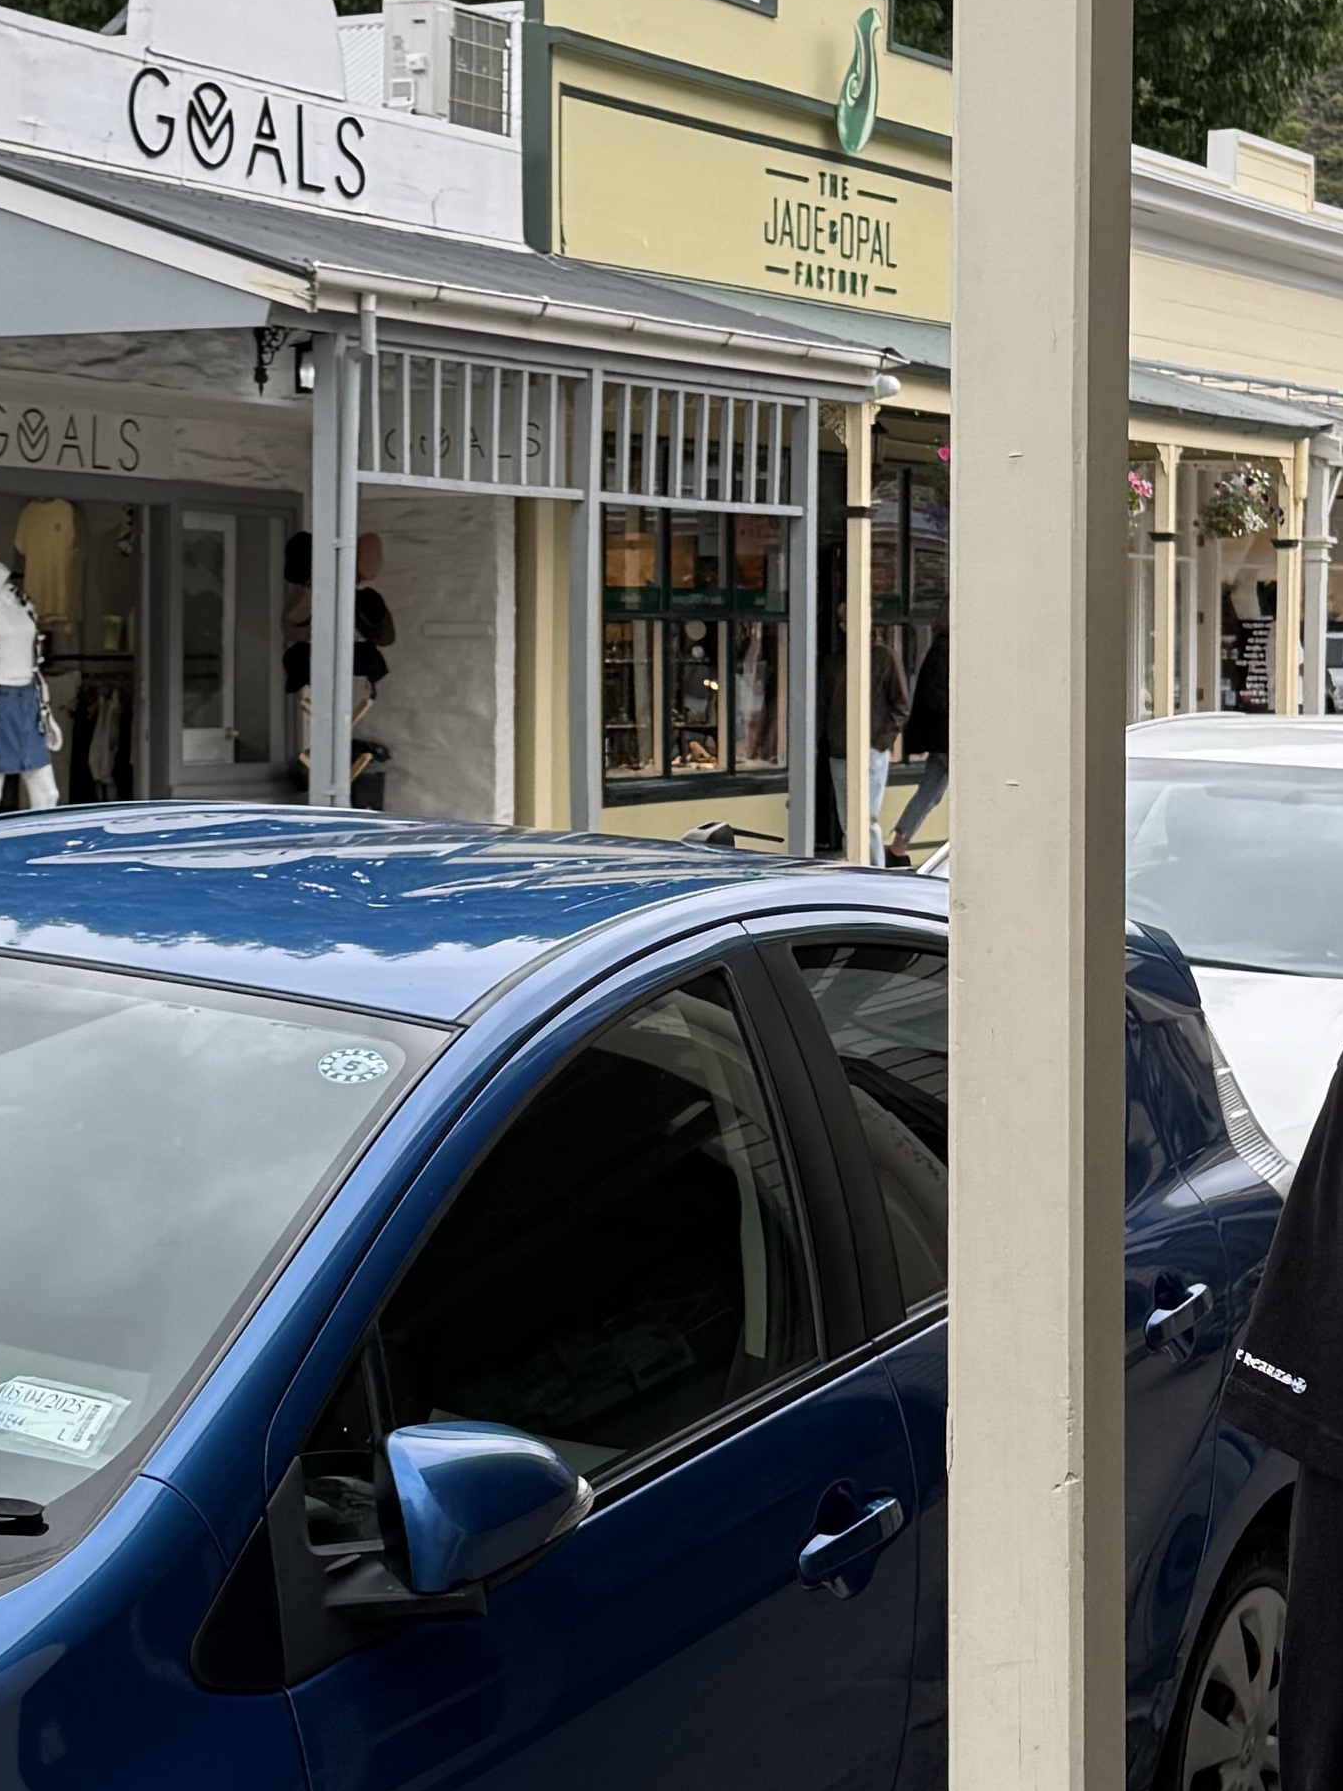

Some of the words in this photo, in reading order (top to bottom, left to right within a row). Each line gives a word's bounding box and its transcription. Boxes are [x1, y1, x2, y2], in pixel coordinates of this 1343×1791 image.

[128, 66, 366, 199] GOALS
[818, 171, 849, 200] THE
[764, 197, 826, 254] JADE
[840, 212, 897, 269] OPAL
[794, 261, 868, 297] FACTORY
